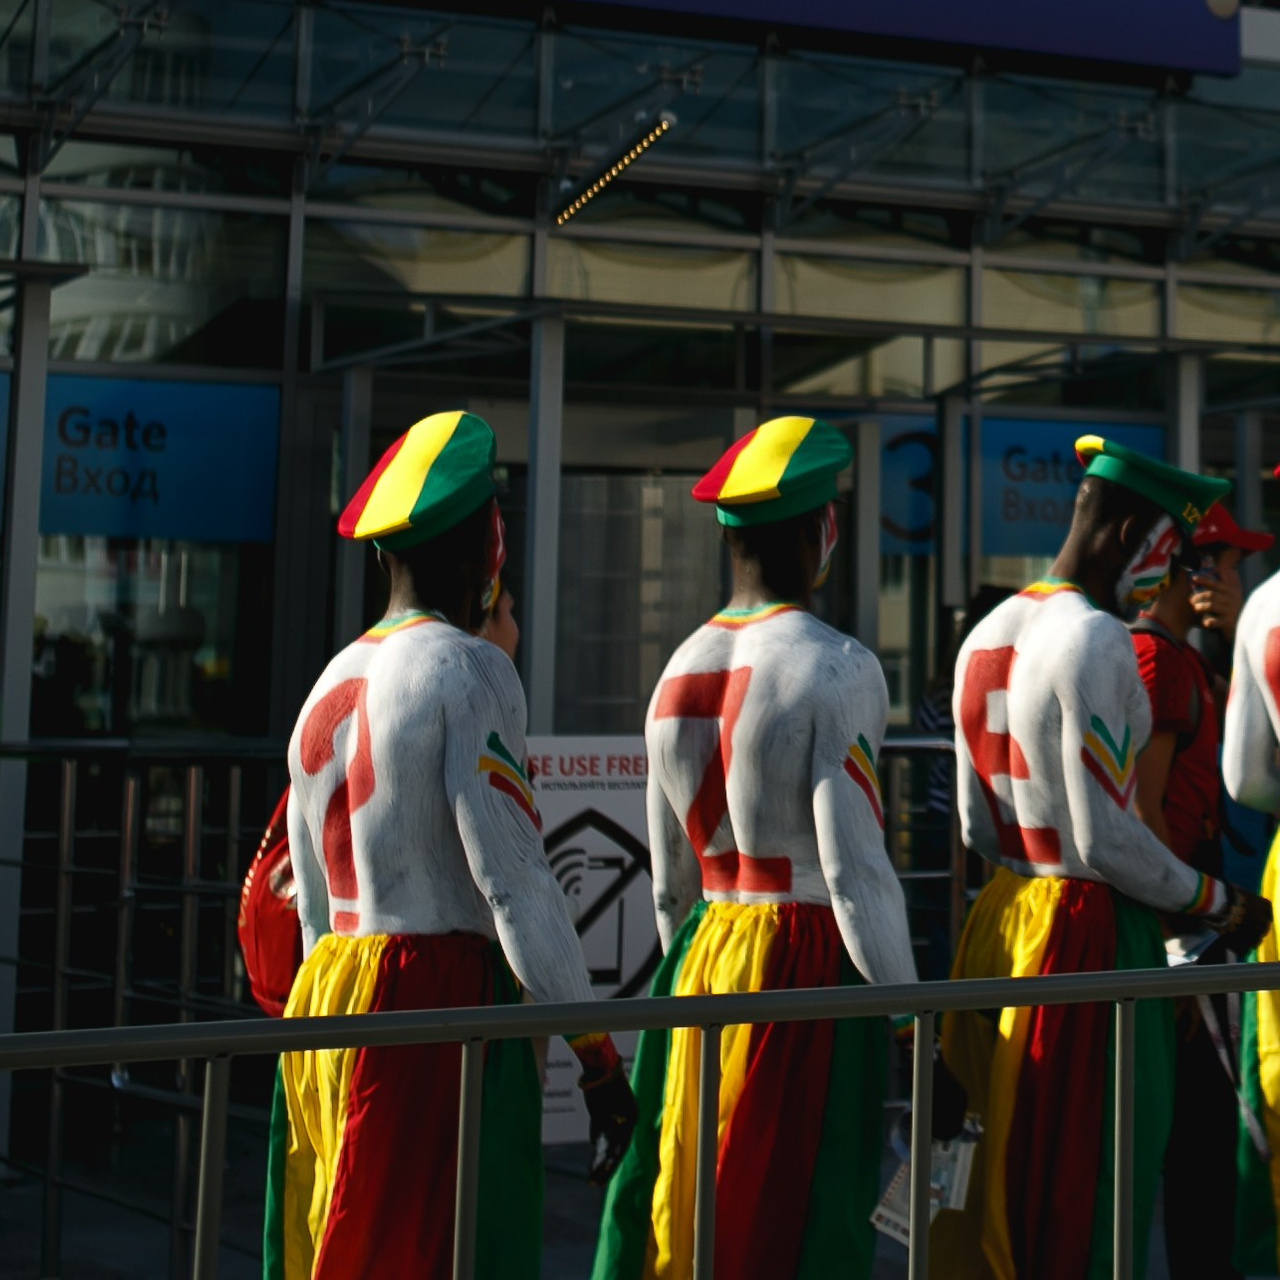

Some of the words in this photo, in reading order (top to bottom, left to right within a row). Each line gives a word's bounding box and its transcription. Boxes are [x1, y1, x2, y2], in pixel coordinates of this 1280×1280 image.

[57, 404, 167, 451] Gate
[53, 453, 160, 504] Вход
[880, 431, 938, 541] 3
[558, 755, 601, 778] USE
[957, 644, 1063, 866] E
